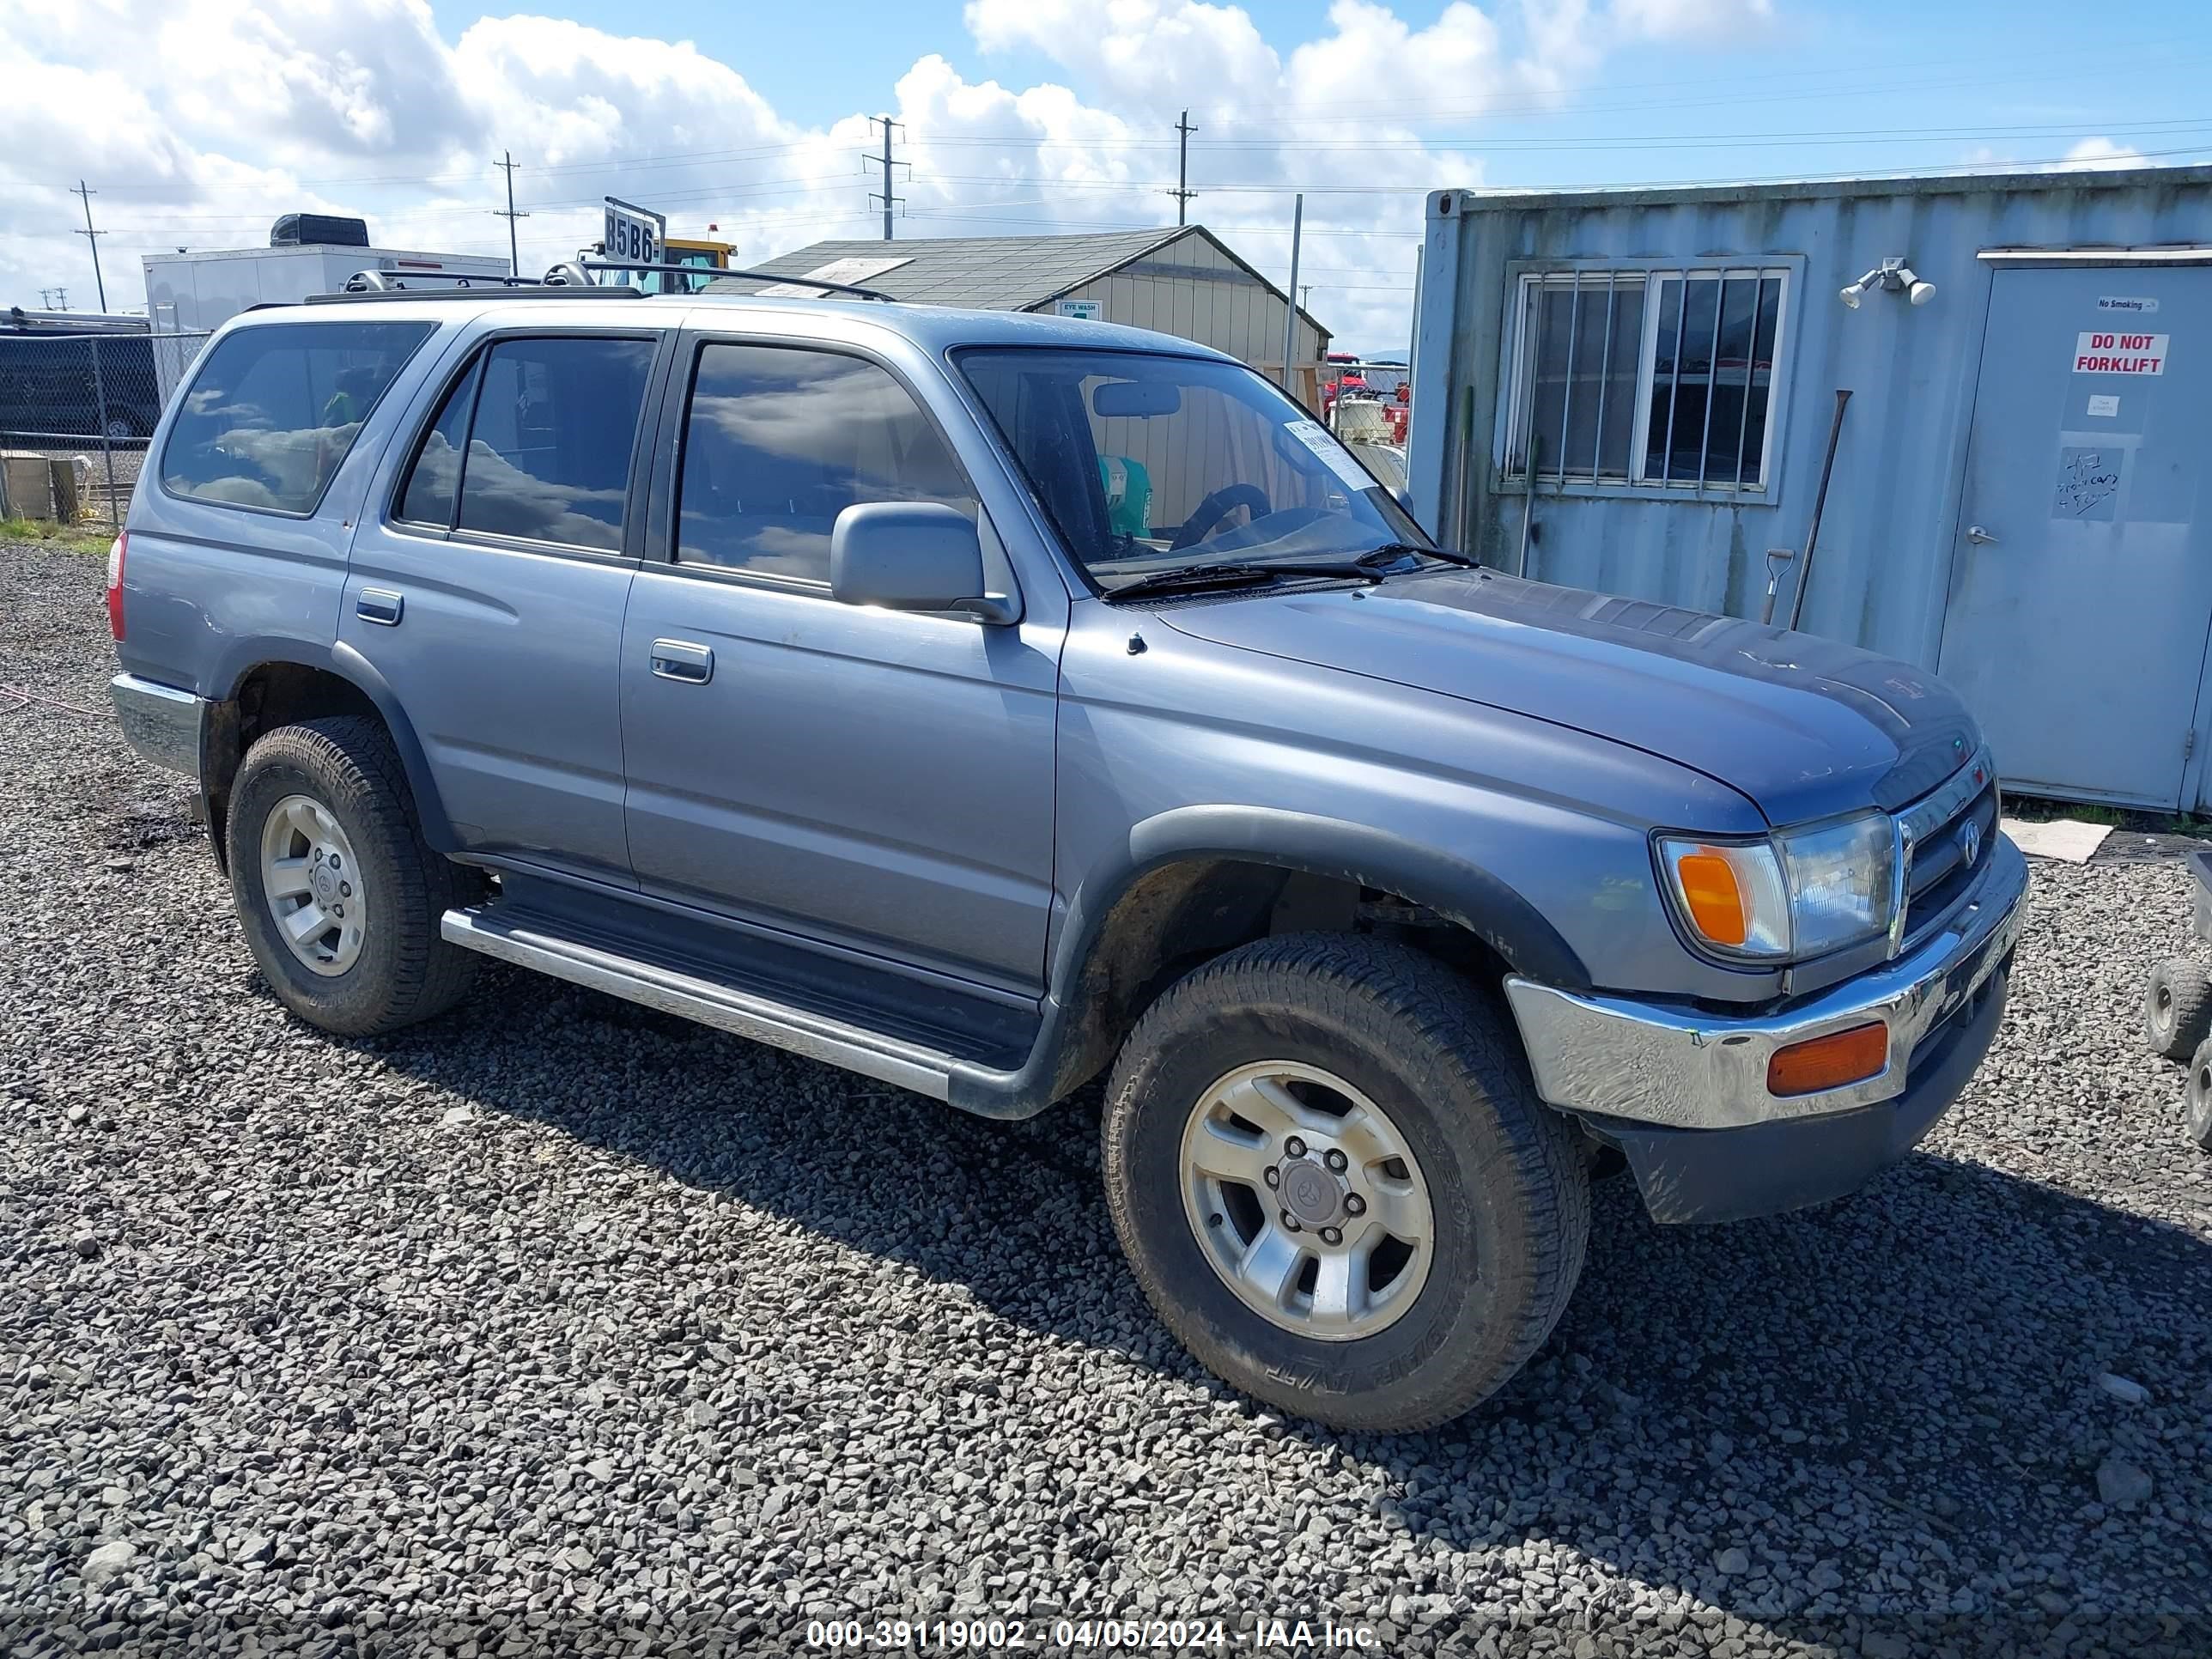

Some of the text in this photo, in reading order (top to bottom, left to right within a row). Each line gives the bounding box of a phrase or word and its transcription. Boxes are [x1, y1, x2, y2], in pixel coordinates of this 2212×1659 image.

[606, 216, 653, 263] B5 B6
[2098, 299, 2143, 311] No Smoking
[2090, 333, 2154, 351] DO NOT
[2076, 356, 2161, 373] FORKLIFT
